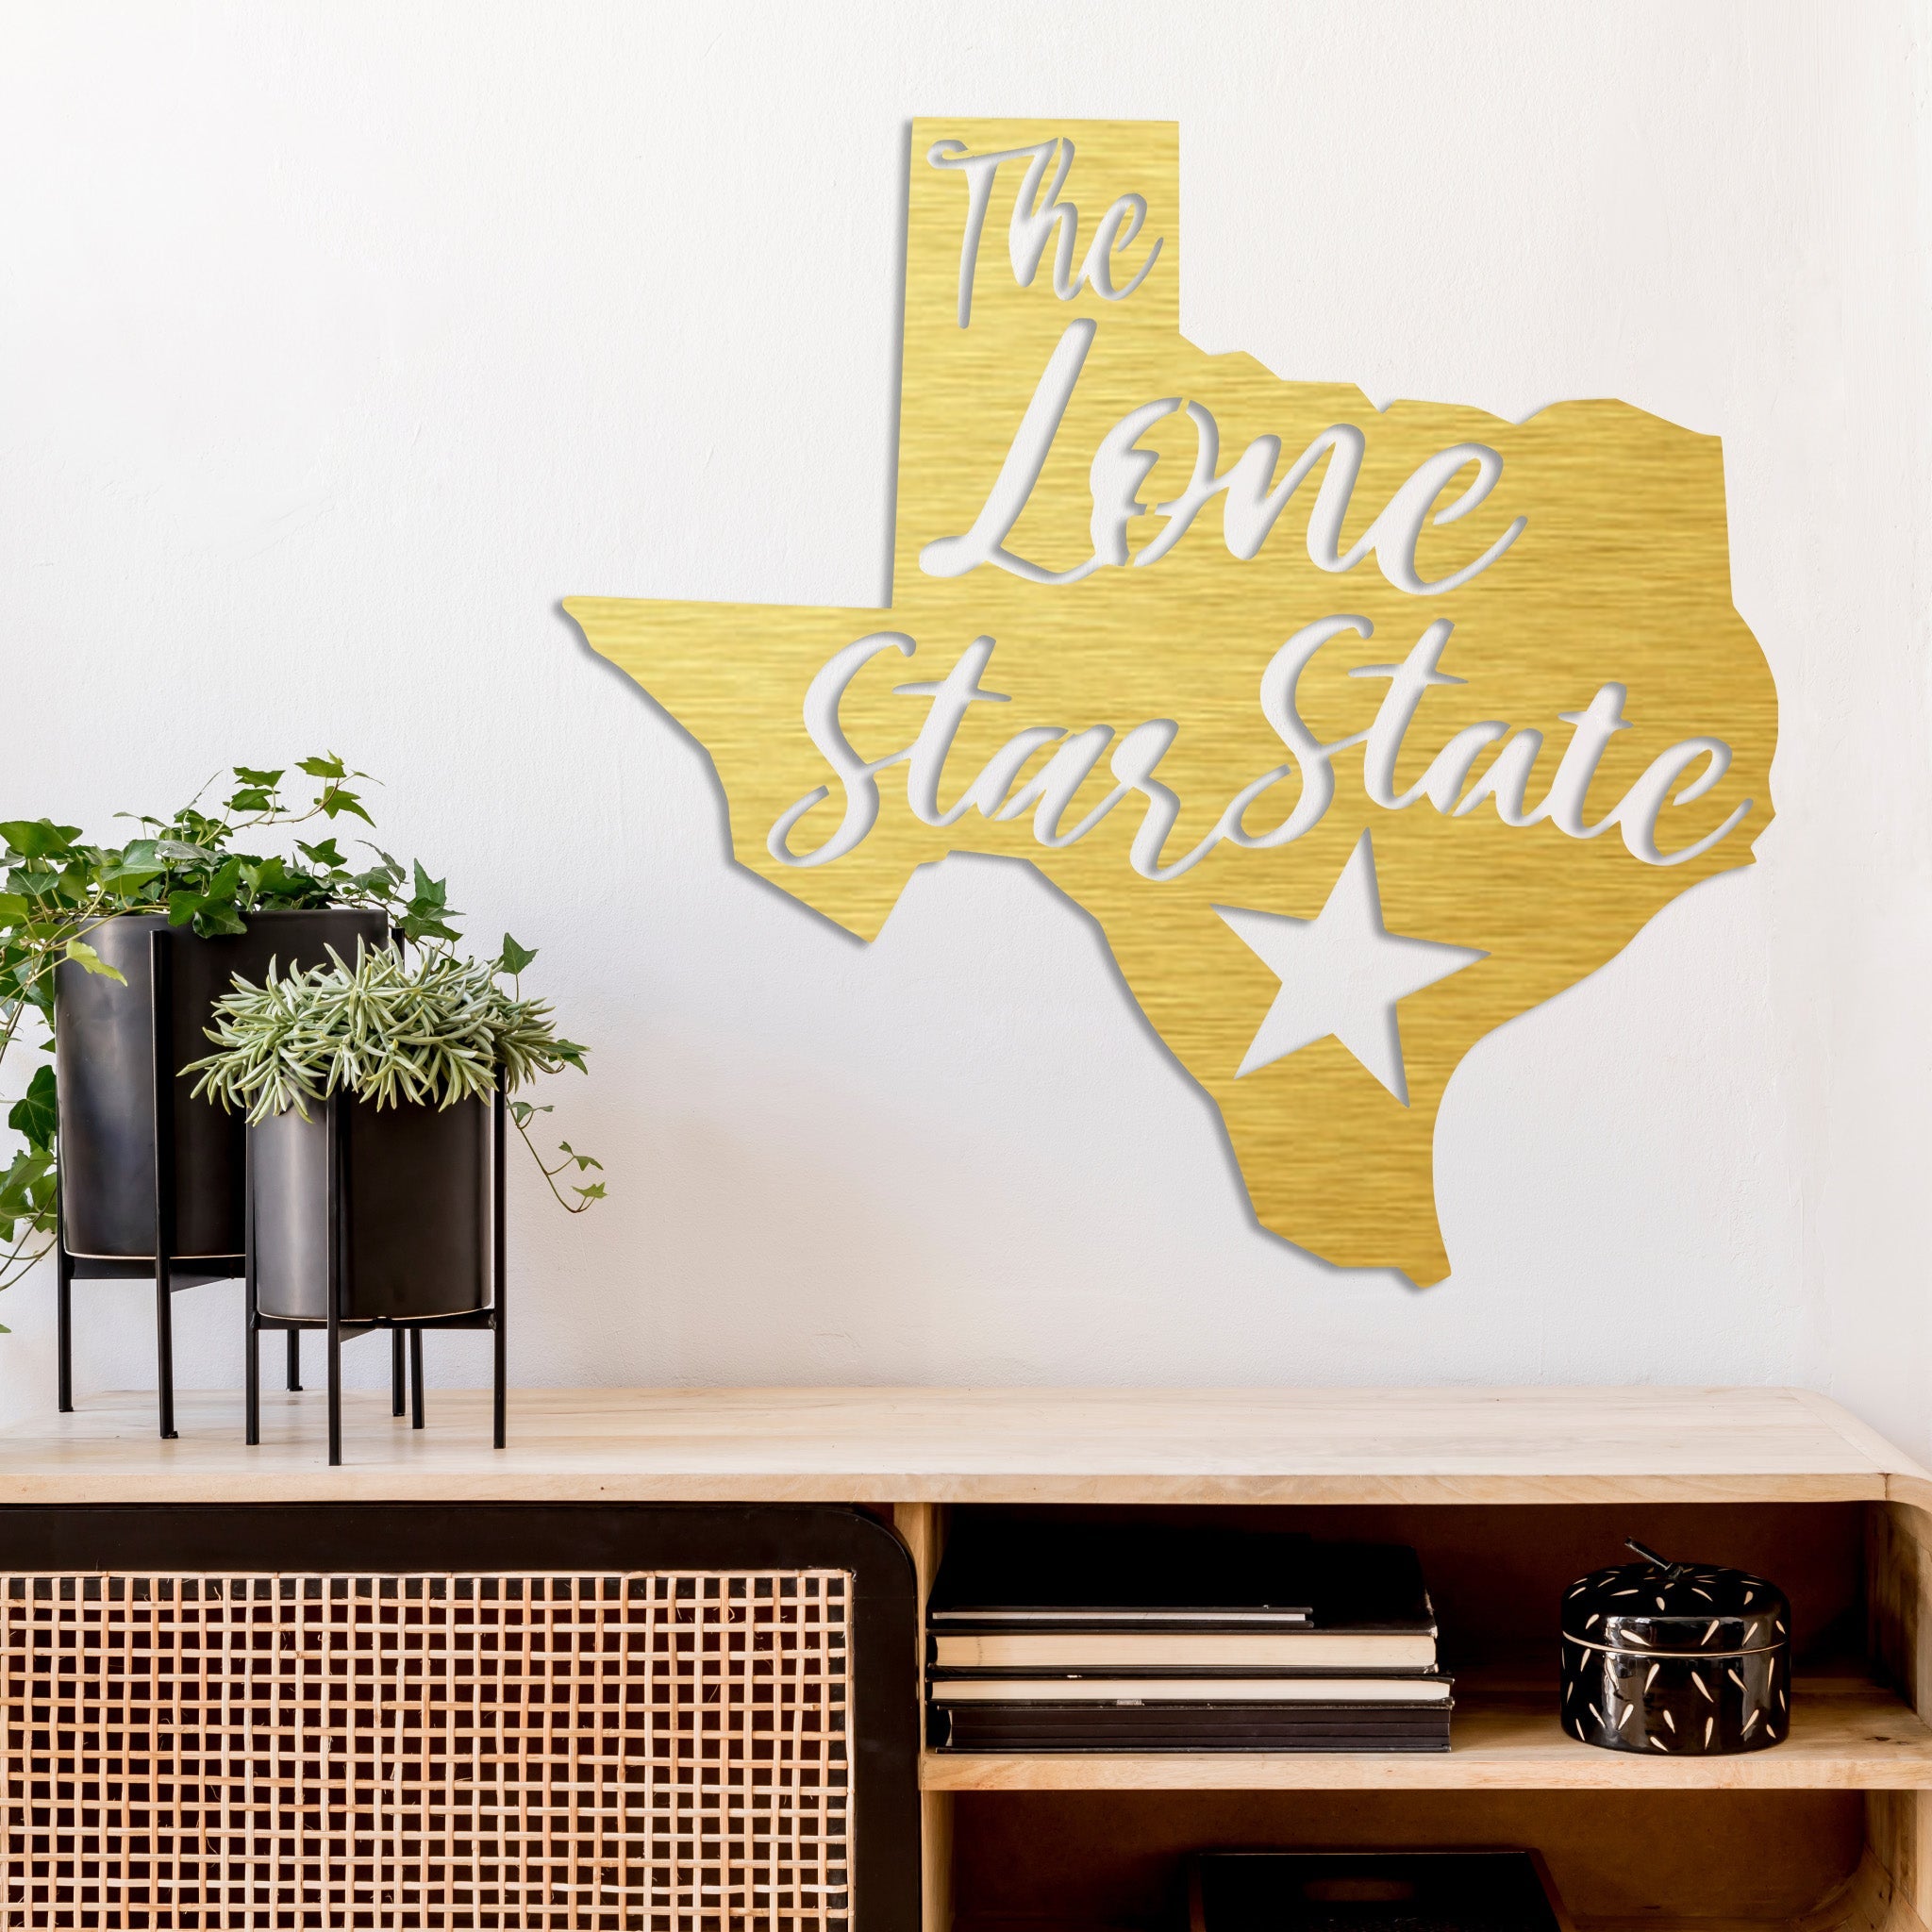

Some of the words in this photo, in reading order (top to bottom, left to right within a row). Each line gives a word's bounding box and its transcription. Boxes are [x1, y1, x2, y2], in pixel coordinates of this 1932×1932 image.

[926, 137, 1164, 329] The
[919, 318, 1528, 595] Lone
[766, 630, 1224, 881] Star
[1221, 613, 1754, 866] State
